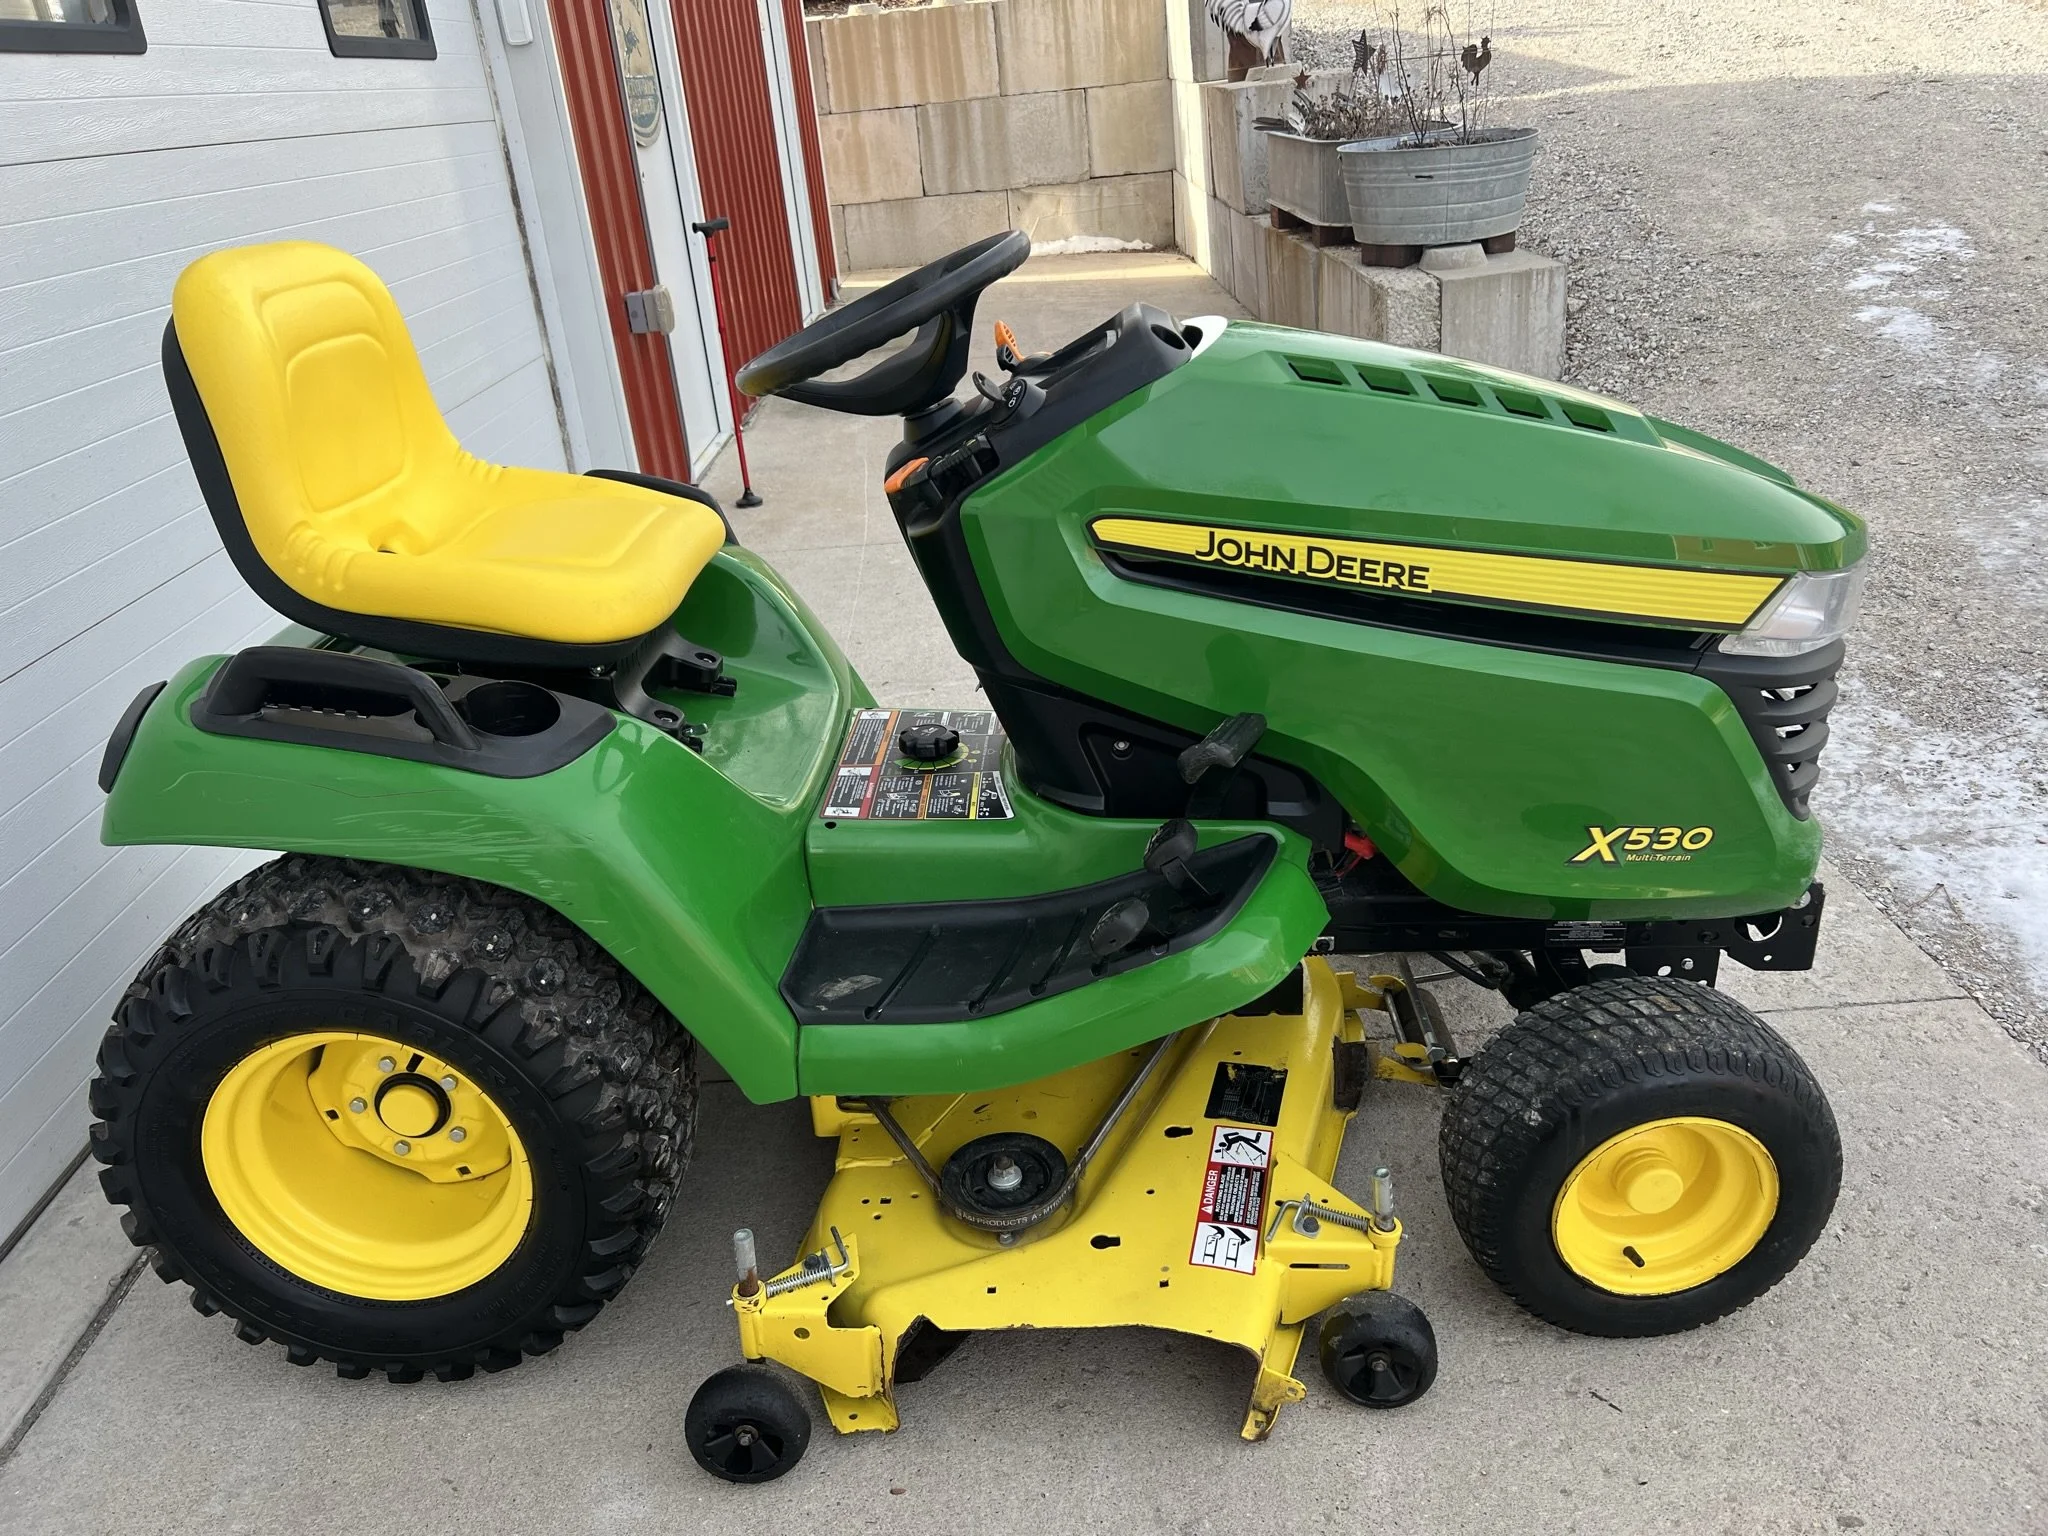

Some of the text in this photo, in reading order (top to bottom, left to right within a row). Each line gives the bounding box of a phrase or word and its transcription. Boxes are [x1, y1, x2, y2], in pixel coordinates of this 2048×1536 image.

[1195, 530, 1430, 590] JOHN DEERE
[1567, 825, 1714, 865] X530
[1625, 853, 1692, 862] Multi-Terrain
[1203, 1169, 1218, 1204] DANGER
[977, 1215, 1028, 1227] PRODUCTS
